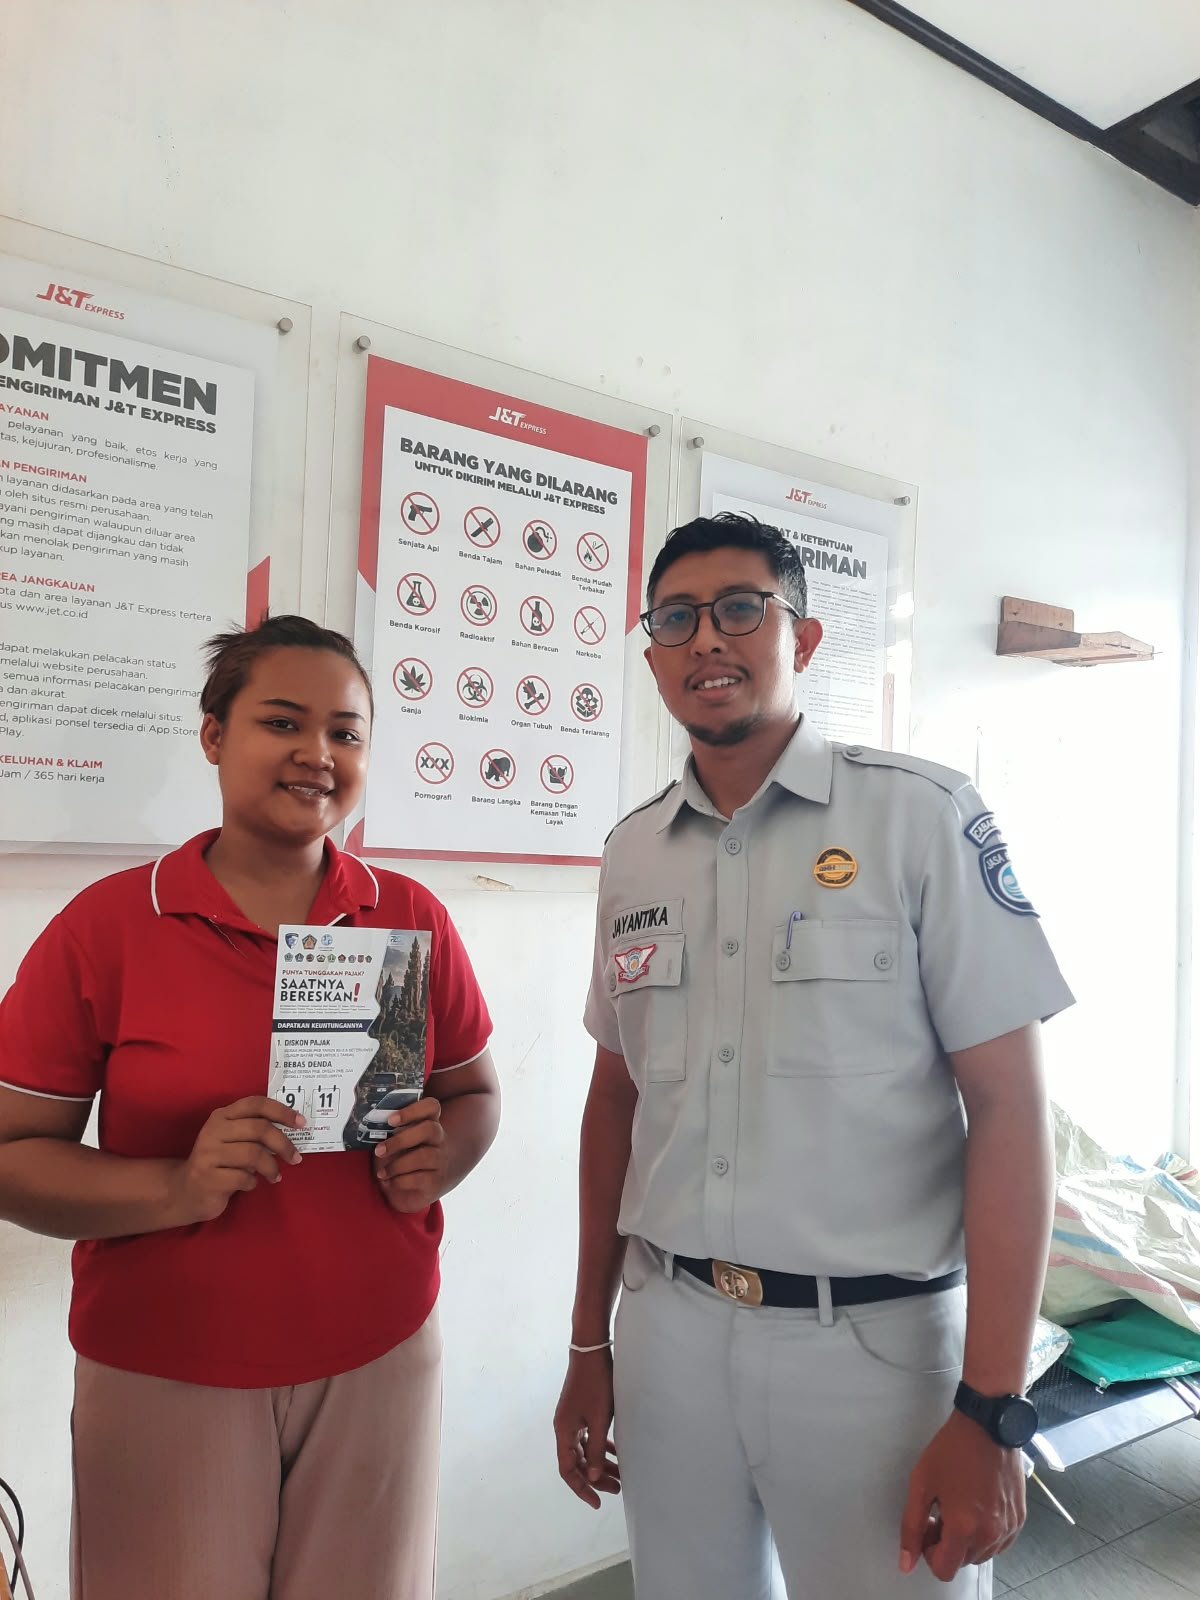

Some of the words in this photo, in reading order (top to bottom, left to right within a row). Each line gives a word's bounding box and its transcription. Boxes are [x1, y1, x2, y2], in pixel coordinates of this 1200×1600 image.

[36, 283, 95, 309] J&T
[84, 303, 125, 320] EXPRESS
[0, 333, 217, 415] MITMEN
[104, 400, 137, 416] J&T
[141, 407, 216, 434] EXPRESS
[488, 406, 526, 427] J&T
[519, 421, 547, 434] EXPRESS
[8, 421, 64, 438] pelayanan
[71, 433, 97, 447] yang
[135, 447, 157, 457] etos
[164, 451, 188, 466] kerja
[195, 459, 218, 471] yang
[13, 462, 87, 483] PENGIRIMAN
[400, 436, 479, 470] BARANG
[482, 458, 532, 483] YANG
[535, 472, 617, 505] DILARANG
[414, 459, 453, 478] UNTUK
[455, 470, 495, 488] DIKIRIM
[497, 480, 541, 499] MELALUI
[543, 492, 561, 504] J&T
[562, 497, 605, 515] EXPRESS
[5, 490, 28, 500] oleh
[32, 493, 56, 505] situs
[59, 499, 88, 511] resmi
[6, 474, 48, 492] layanan
[52, 483, 108, 500] didasarkan
[111, 495, 137, 507] pada
[139, 500, 160, 511] area
[164, 505, 188, 517] yang
[190, 507, 213, 520] telah
[785, 487, 812, 504] J&T
[30, 508, 90, 525] pengiriman
[93, 518, 142, 535] walaupun
[145, 527, 173, 540] diluar
[175, 533, 195, 543] area
[18, 519, 49, 531] masih
[52, 524, 84, 537] dapat
[87, 529, 132, 546] dijangkau
[138, 538, 157, 548] dan
[160, 542, 183, 554] tidak
[397, 537, 425, 549] Senjata
[426, 543, 439, 552] Api
[793, 531, 799, 540] &
[800, 532, 853, 553] KETENTUAN
[24, 533, 69, 548] menolak
[72, 542, 131, 561] pengiriman
[133, 552, 157, 564] yang
[160, 555, 188, 567] masih
[458, 550, 481, 561] Benda
[481, 555, 503, 565] Tajam
[514, 561, 535, 572] Bahan
[536, 566, 562, 577] Peledak
[0, 571, 17, 582] EA
[21, 575, 95, 592] JANGKAUAN
[571, 574, 591, 583] Benda
[592, 578, 612, 588] Mudah
[578, 583, 605, 595] Terbakar
[16, 603, 88, 619] www.jet.co.id
[19, 589, 40, 599] dan
[44, 593, 68, 603] area
[72, 595, 111, 609] layanan
[115, 602, 133, 612] J&T
[138, 605, 176, 618] Express
[180, 611, 211, 622] tertera
[389, 619, 413, 629] Benda
[414, 623, 441, 634] Korosif
[459, 631, 495, 642] Radioaktif
[511, 639, 531, 648] Bahan
[532, 642, 559, 653] Beracun
[575, 649, 601, 659] Narkoba
[0, 657, 39, 668] melalui
[43, 662, 83, 673] website
[32, 647, 89, 660] melakukan
[93, 653, 144, 666] pelacakan
[147, 659, 176, 669] status
[3, 673, 39, 683] semua
[43, 675, 91, 688] informasi
[94, 680, 145, 694] pelacakan
[7, 685, 28, 695] dan
[57, 702, 87, 715] dapat
[91, 706, 118, 717] dicek
[121, 709, 156, 720] melalui
[400, 705, 421, 715] Ganja
[458, 713, 489, 723] Biokimia
[12, 715, 52, 725] aplikasi
[56, 717, 90, 728] ponsel
[93, 720, 133, 731] tersedia
[136, 722, 146, 732] di
[149, 726, 169, 737] App
[173, 726, 199, 736] Store
[510, 719, 531, 728] Organ
[532, 721, 552, 730] Tubuh
[560, 725, 580, 734] Benda
[581, 728, 610, 738] Terlarang
[56, 758, 64, 767] &
[67, 758, 102, 769] KLAIM
[420, 756, 450, 771] XXX
[33, 771, 54, 781] 365
[57, 771, 77, 782] hari
[80, 774, 105, 785] kerja
[413, 791, 452, 801] Pornografi
[471, 795, 495, 804] Barang
[496, 797, 521, 806] Langka
[530, 800, 553, 808] Barang
[554, 801, 578, 810] Dengan
[530, 808, 559, 816] Kemasan
[545, 818, 564, 826] Layak
[986, 853, 1005, 870] JASA
[612, 906, 669, 939] JAYANTIKA
[304, 969, 344, 977] TUNGGAKAN
[281, 978, 345, 990] SAATNYA
[284, 1039, 308, 1047] DISKON
[310, 1039, 331, 1047] PAJAK
[283, 1060, 306, 1069] BEBAS
[307, 1060, 332, 1069] DENDA
[286, 1093, 295, 1109] 9
[319, 1093, 333, 1108] 11
